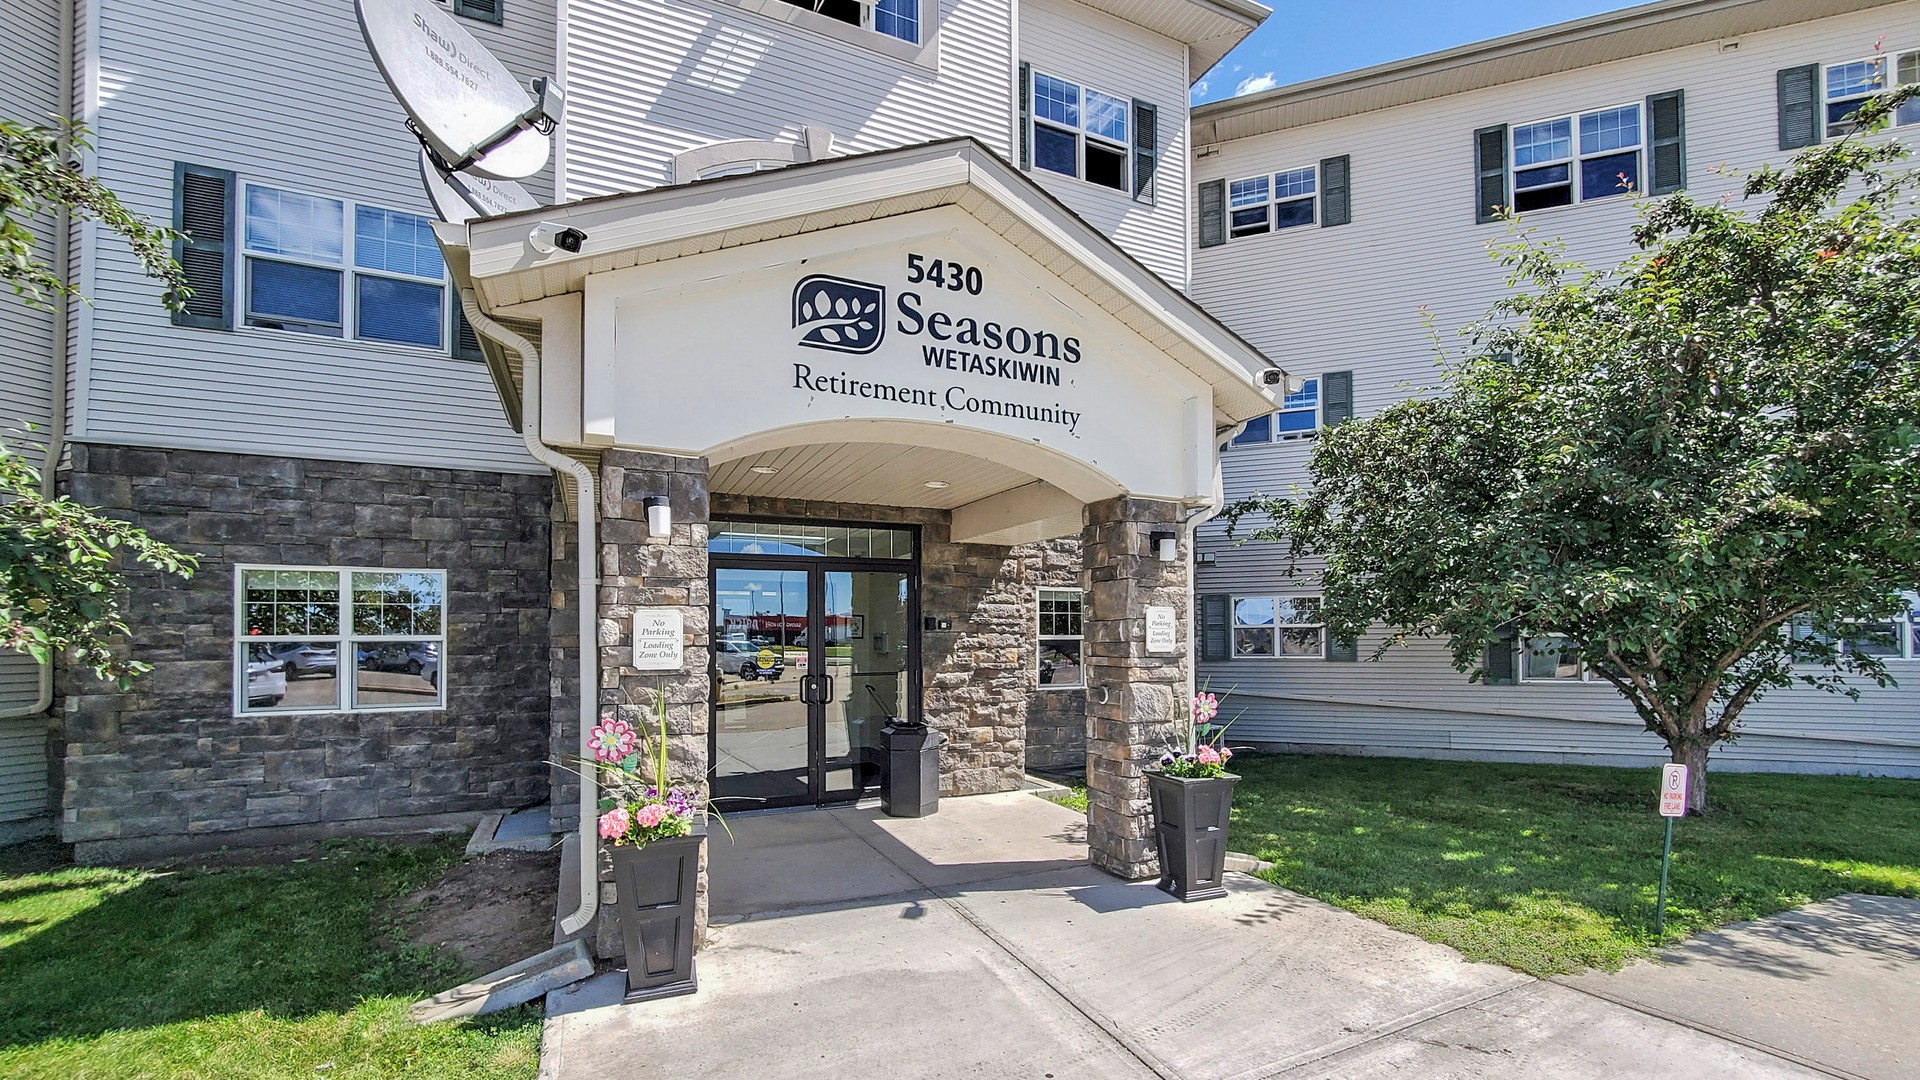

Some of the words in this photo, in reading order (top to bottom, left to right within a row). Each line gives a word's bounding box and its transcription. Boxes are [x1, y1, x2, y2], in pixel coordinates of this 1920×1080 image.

[458, 52, 491, 81] Direct
[492, 185, 516, 205] Direct
[907, 253, 983, 295] 5430
[897, 292, 1082, 364] Seasons
[922, 345, 1060, 387] WETASKIWIN
[793, 363, 937, 407] Retirement
[945, 386, 1081, 432] Community
[641, 628, 676, 637] Parking
[652, 619, 666, 627] No
[643, 641, 674, 650] Loading
[1161, 637, 1173, 645] Only
[639, 651, 658, 659] Zone
[659, 650, 678, 660] Only
